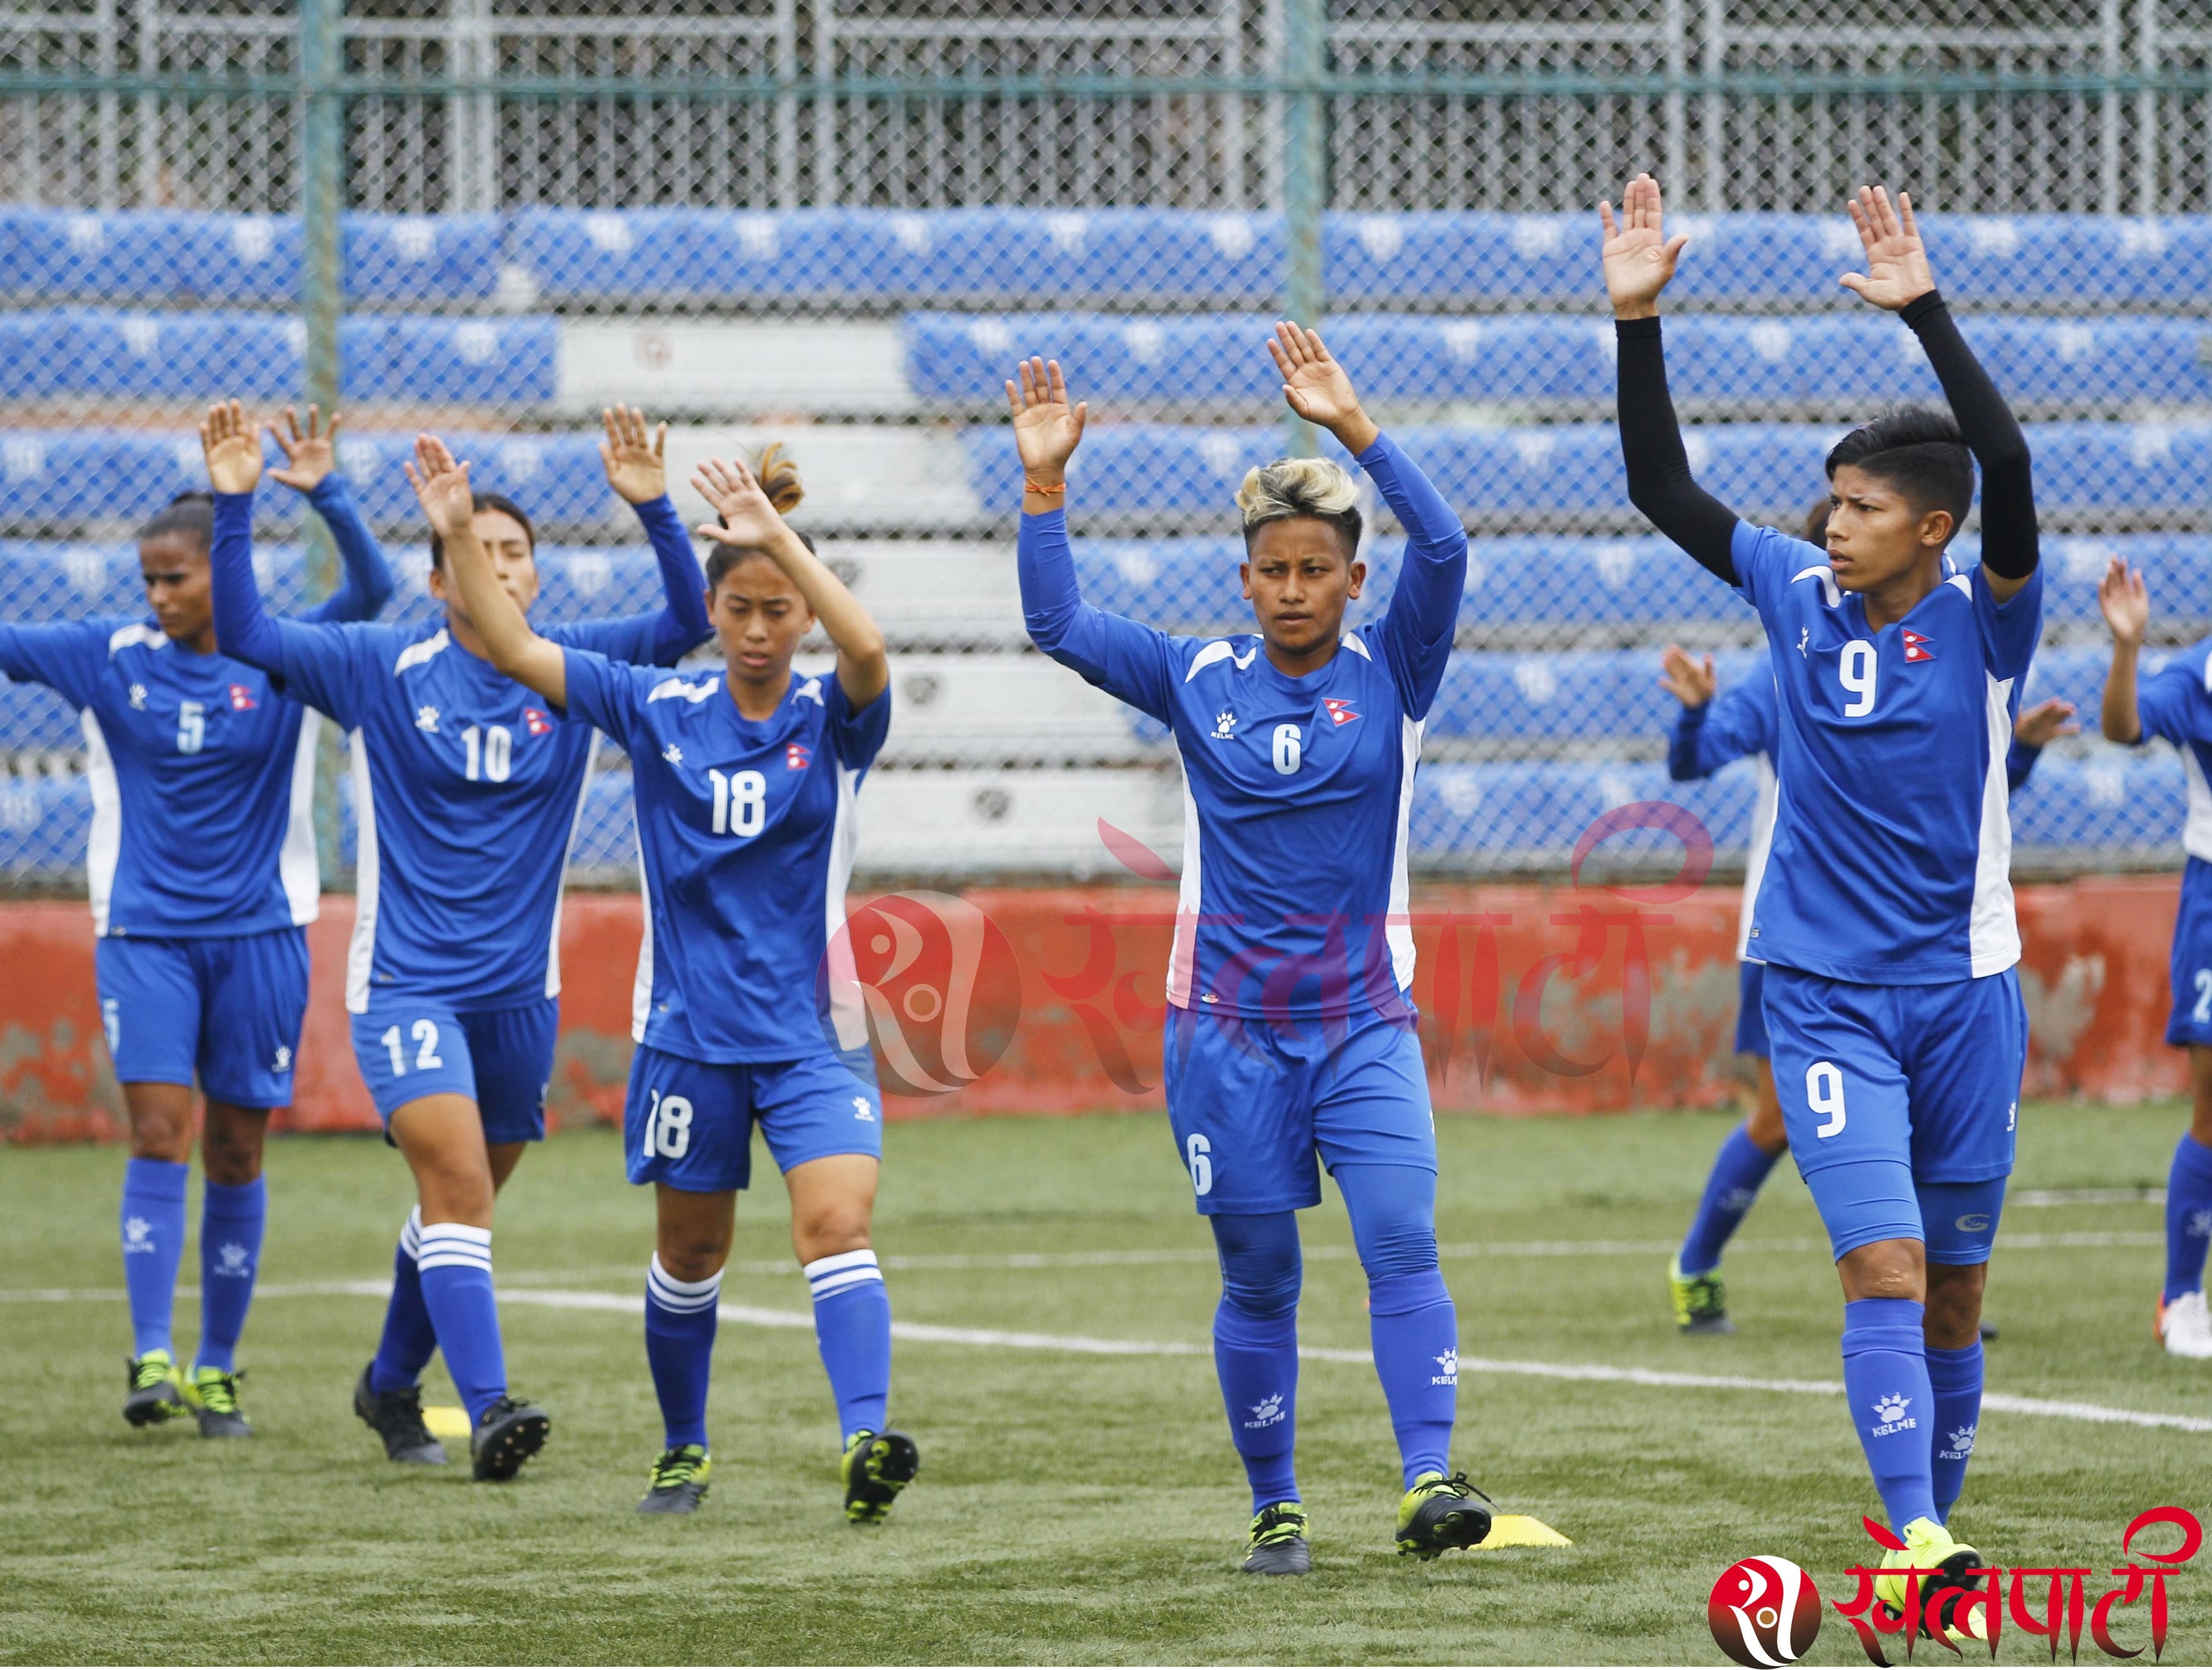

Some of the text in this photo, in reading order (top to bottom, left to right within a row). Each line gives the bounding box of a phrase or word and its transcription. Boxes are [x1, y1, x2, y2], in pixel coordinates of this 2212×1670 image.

[1839, 639, 1877, 718] 9
[177, 700, 205, 755] 5
[460, 725, 512, 783] 10
[1272, 723, 1302, 775] 6
[708, 768, 767, 838] 18
[380, 1019, 444, 1078] 12
[643, 1089, 694, 1158] 18
[1805, 1061, 1847, 1138] 9
[1187, 1133, 1212, 1196] 6
[1244, 1411, 1286, 1429] KELME
[1872, 1418, 1917, 1438] KELME
